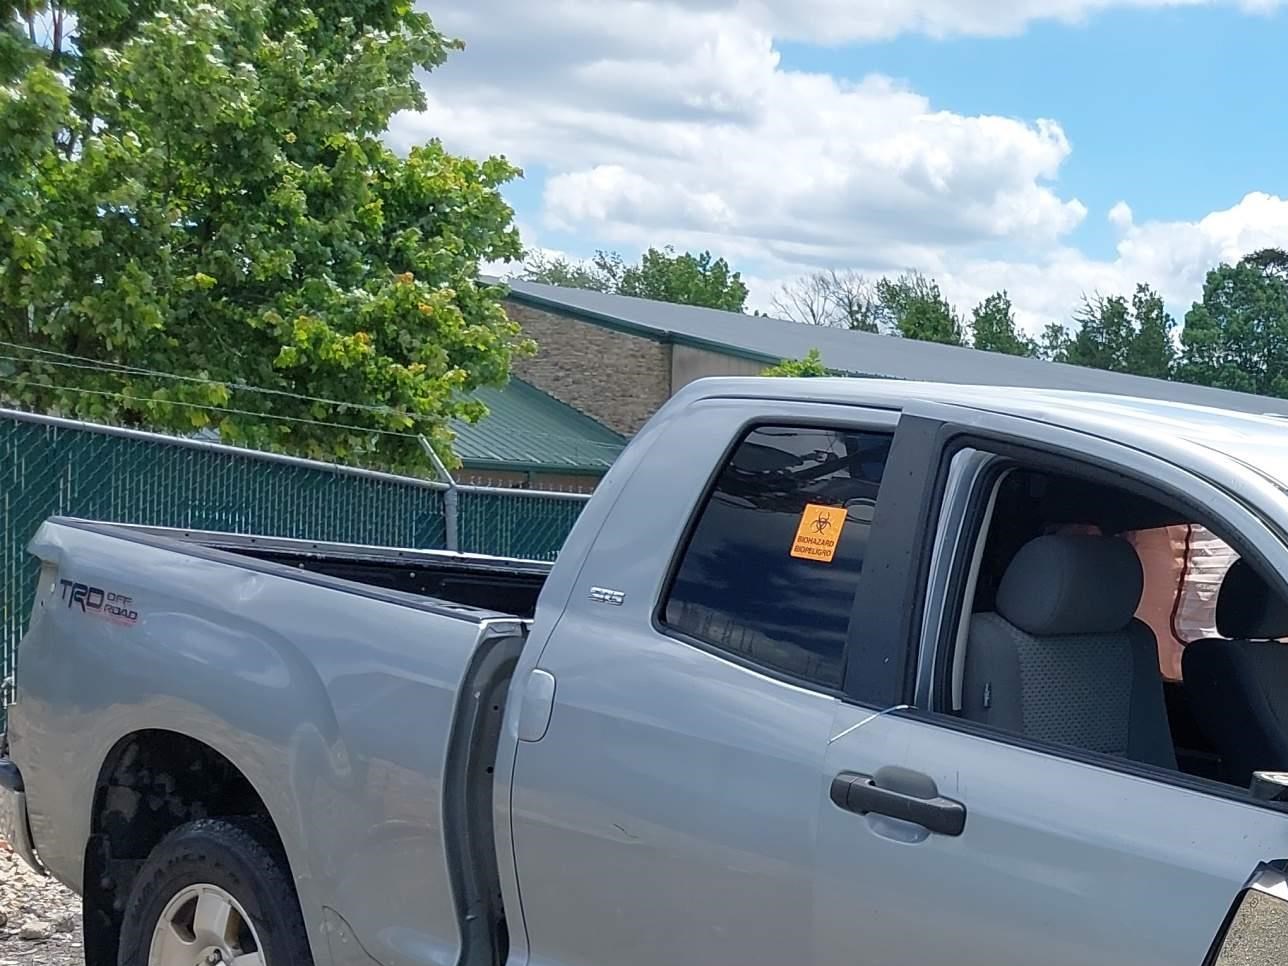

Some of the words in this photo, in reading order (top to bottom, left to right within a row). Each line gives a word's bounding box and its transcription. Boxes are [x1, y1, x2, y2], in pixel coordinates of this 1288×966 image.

[797, 535, 835, 547] BIOHAZARD
[794, 545, 831, 557] BIOPELIGRO
[60, 578, 104, 612] TRD
[104, 604, 138, 620] ROAD
